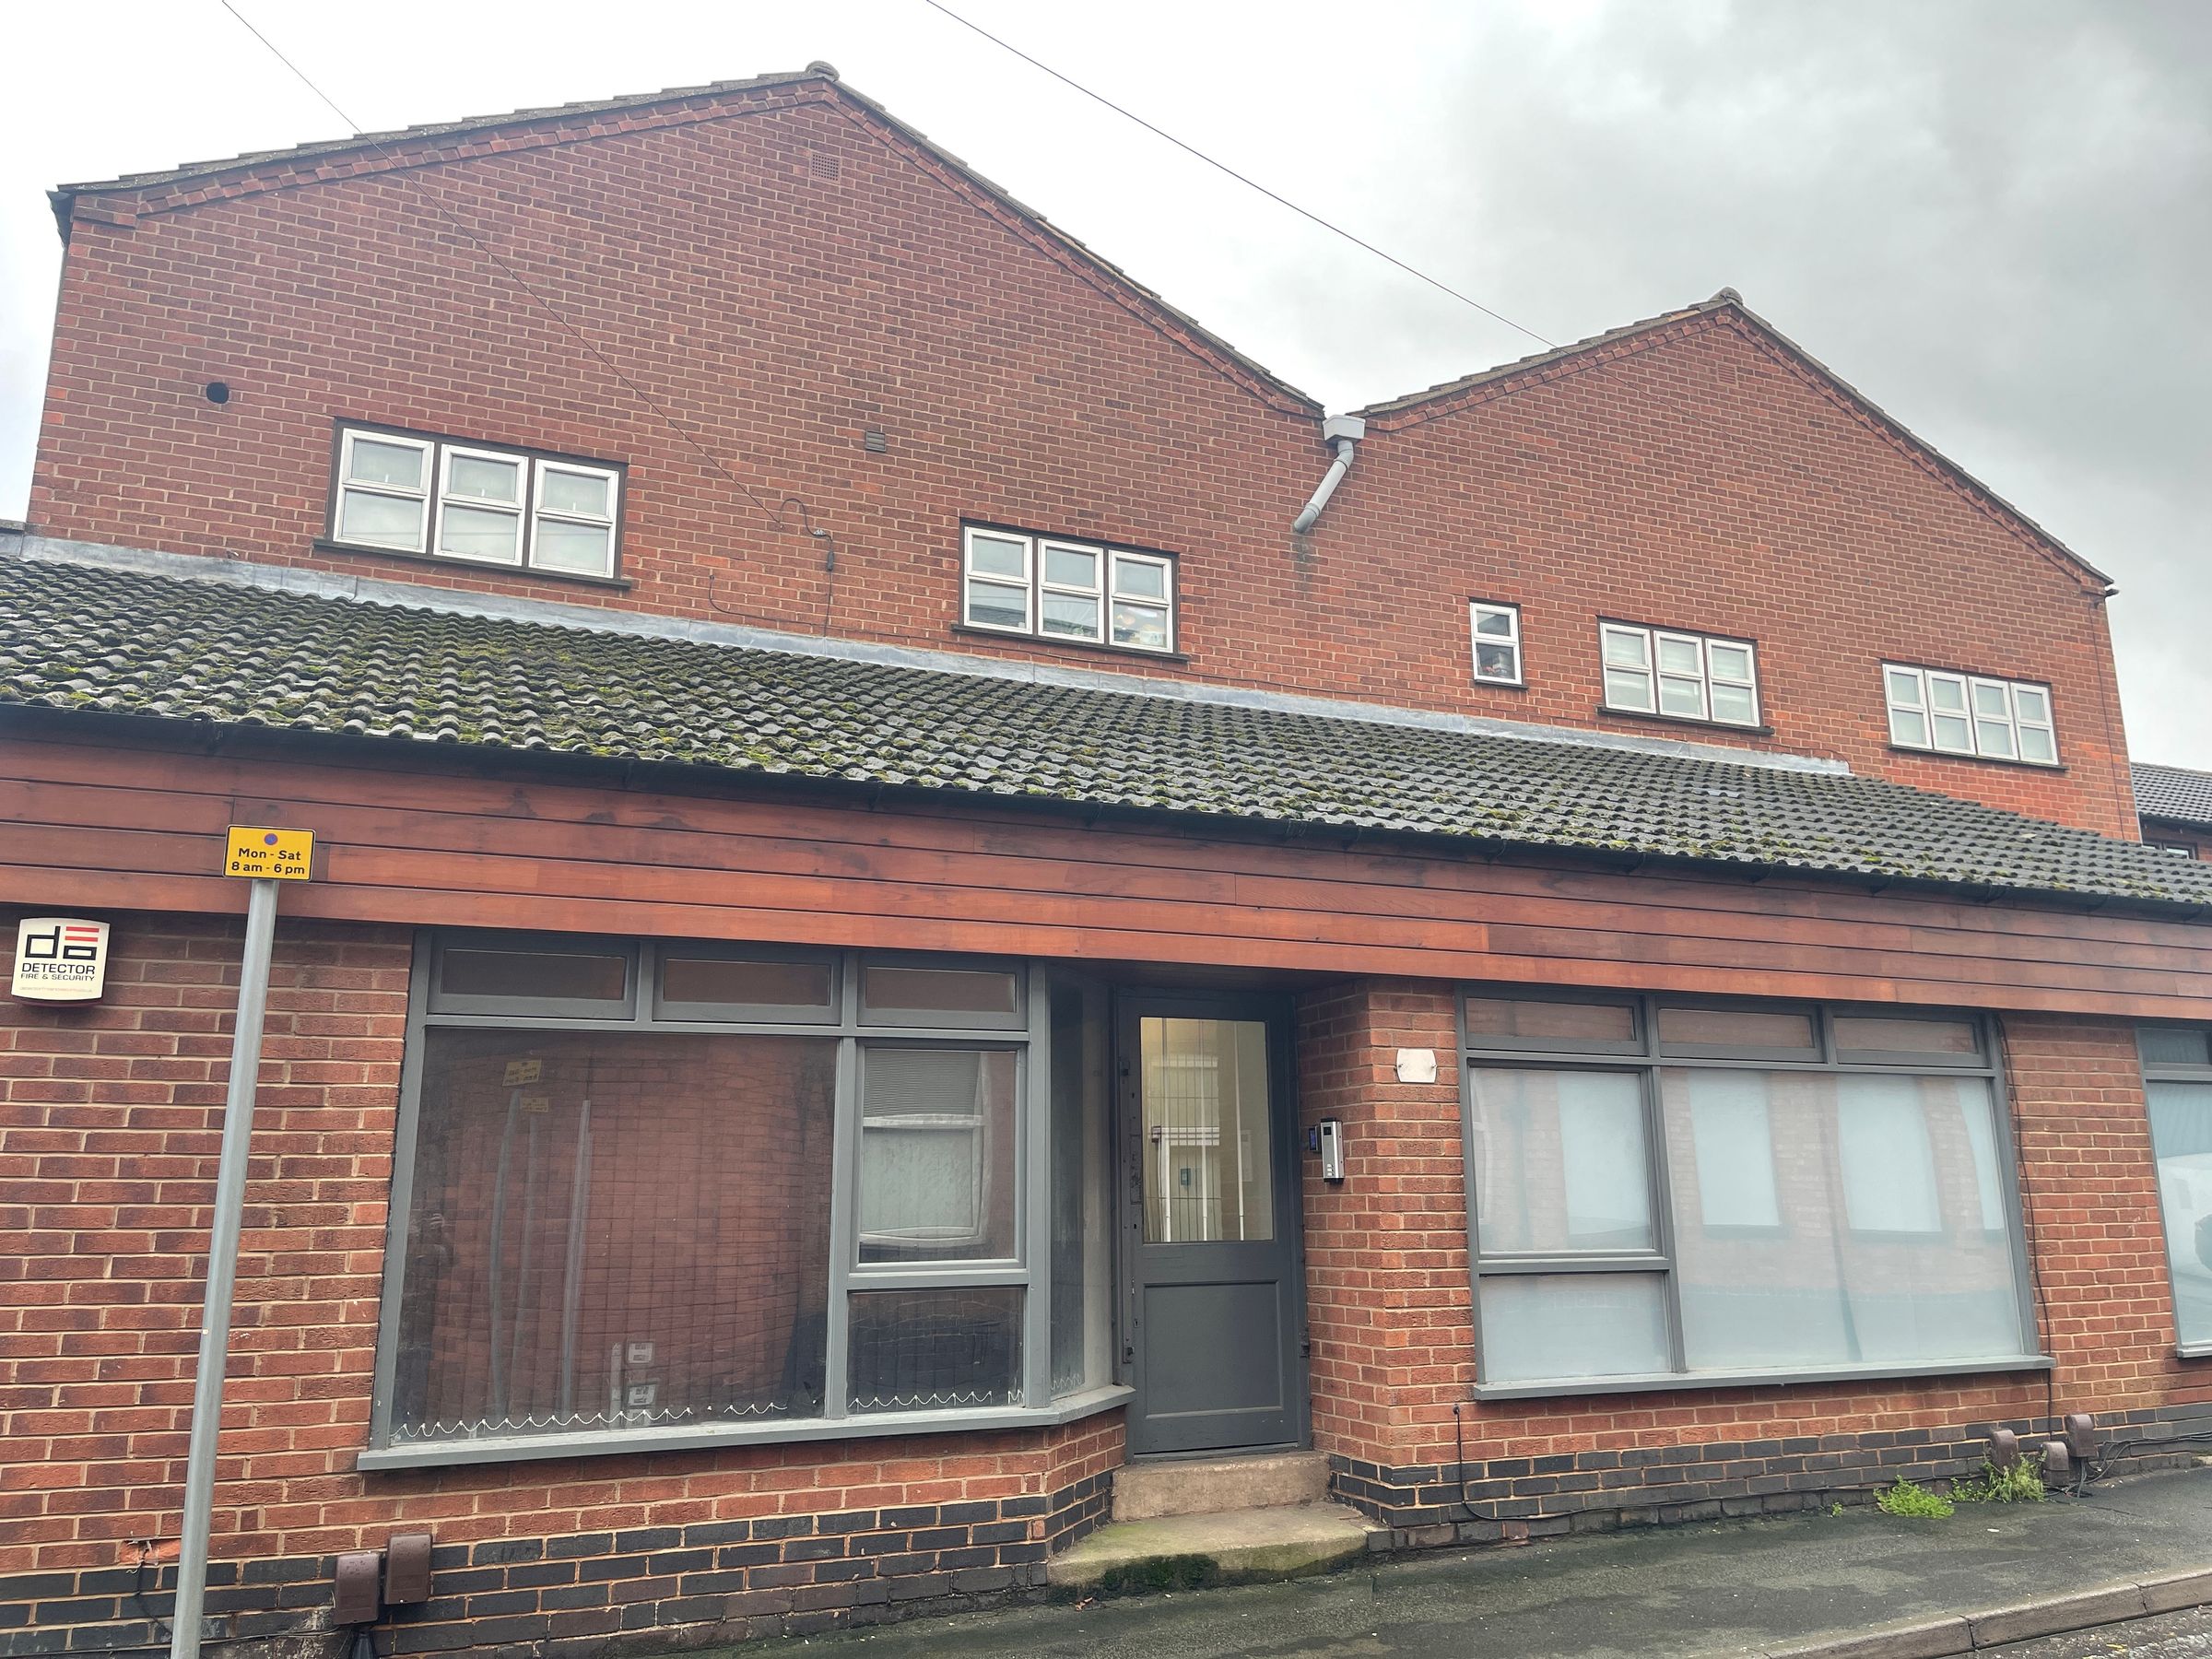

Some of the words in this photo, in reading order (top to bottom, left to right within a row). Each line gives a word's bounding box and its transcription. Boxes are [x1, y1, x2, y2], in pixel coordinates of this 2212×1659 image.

[238, 848, 266, 858] Mon
[277, 850, 301, 861] Sat
[231, 861, 240, 871] 8
[243, 864, 263, 872] am
[274, 864, 282, 873] 6
[285, 865, 305, 876] pm
[21, 962, 96, 974] DETECTOR
